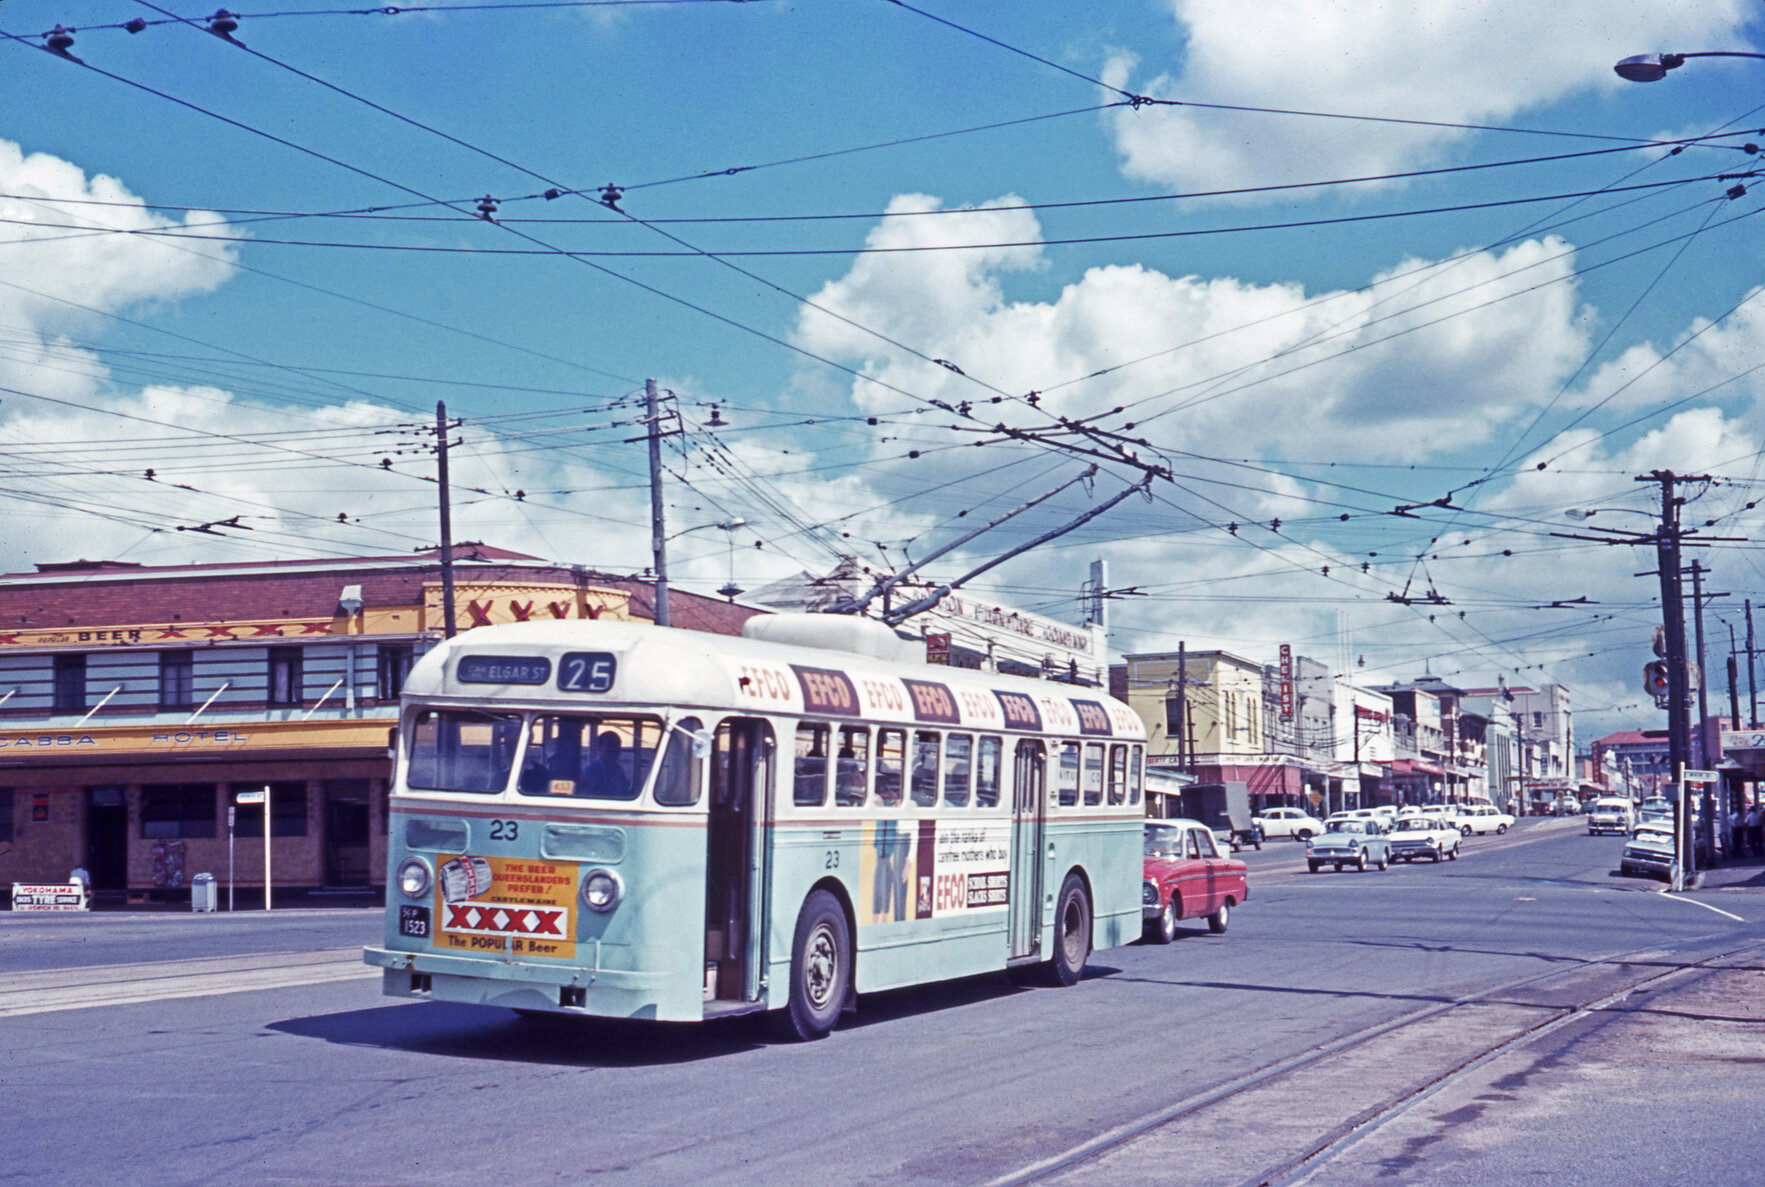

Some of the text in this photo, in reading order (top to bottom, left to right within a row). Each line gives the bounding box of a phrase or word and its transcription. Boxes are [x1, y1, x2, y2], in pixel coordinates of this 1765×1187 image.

[78, 630, 141, 642] BEER
[488, 665, 546, 680] ELGAR ST
[567, 659, 611, 690] 25
[741, 666, 790, 701] EFCO
[803, 672, 850, 709] EFCO
[862, 680, 904, 711] EFCO
[911, 684, 953, 717] EFCO
[961, 691, 996, 720] EFCO
[1000, 694, 1036, 724] EFCO
[1077, 704, 1108, 730] EFCO
[152, 730, 249, 744] HOTEL
[490, 819, 518, 841] 23
[826, 850, 840, 869] 23
[986, 844, 997, 860] who
[998, 844, 1008, 864] buy
[505, 864, 556, 874] THE BEER
[494, 873, 571, 886] QUEENSLANDERS
[32, 895, 56, 905] TYRE
[490, 896, 557, 905] CASTLEMAINE
[936, 873, 966, 911] EFCO
[404, 920, 426, 935] 1523
[446, 904, 563, 935] XXXX
[448, 934, 467, 948] The
[528, 940, 558, 953] Beer
